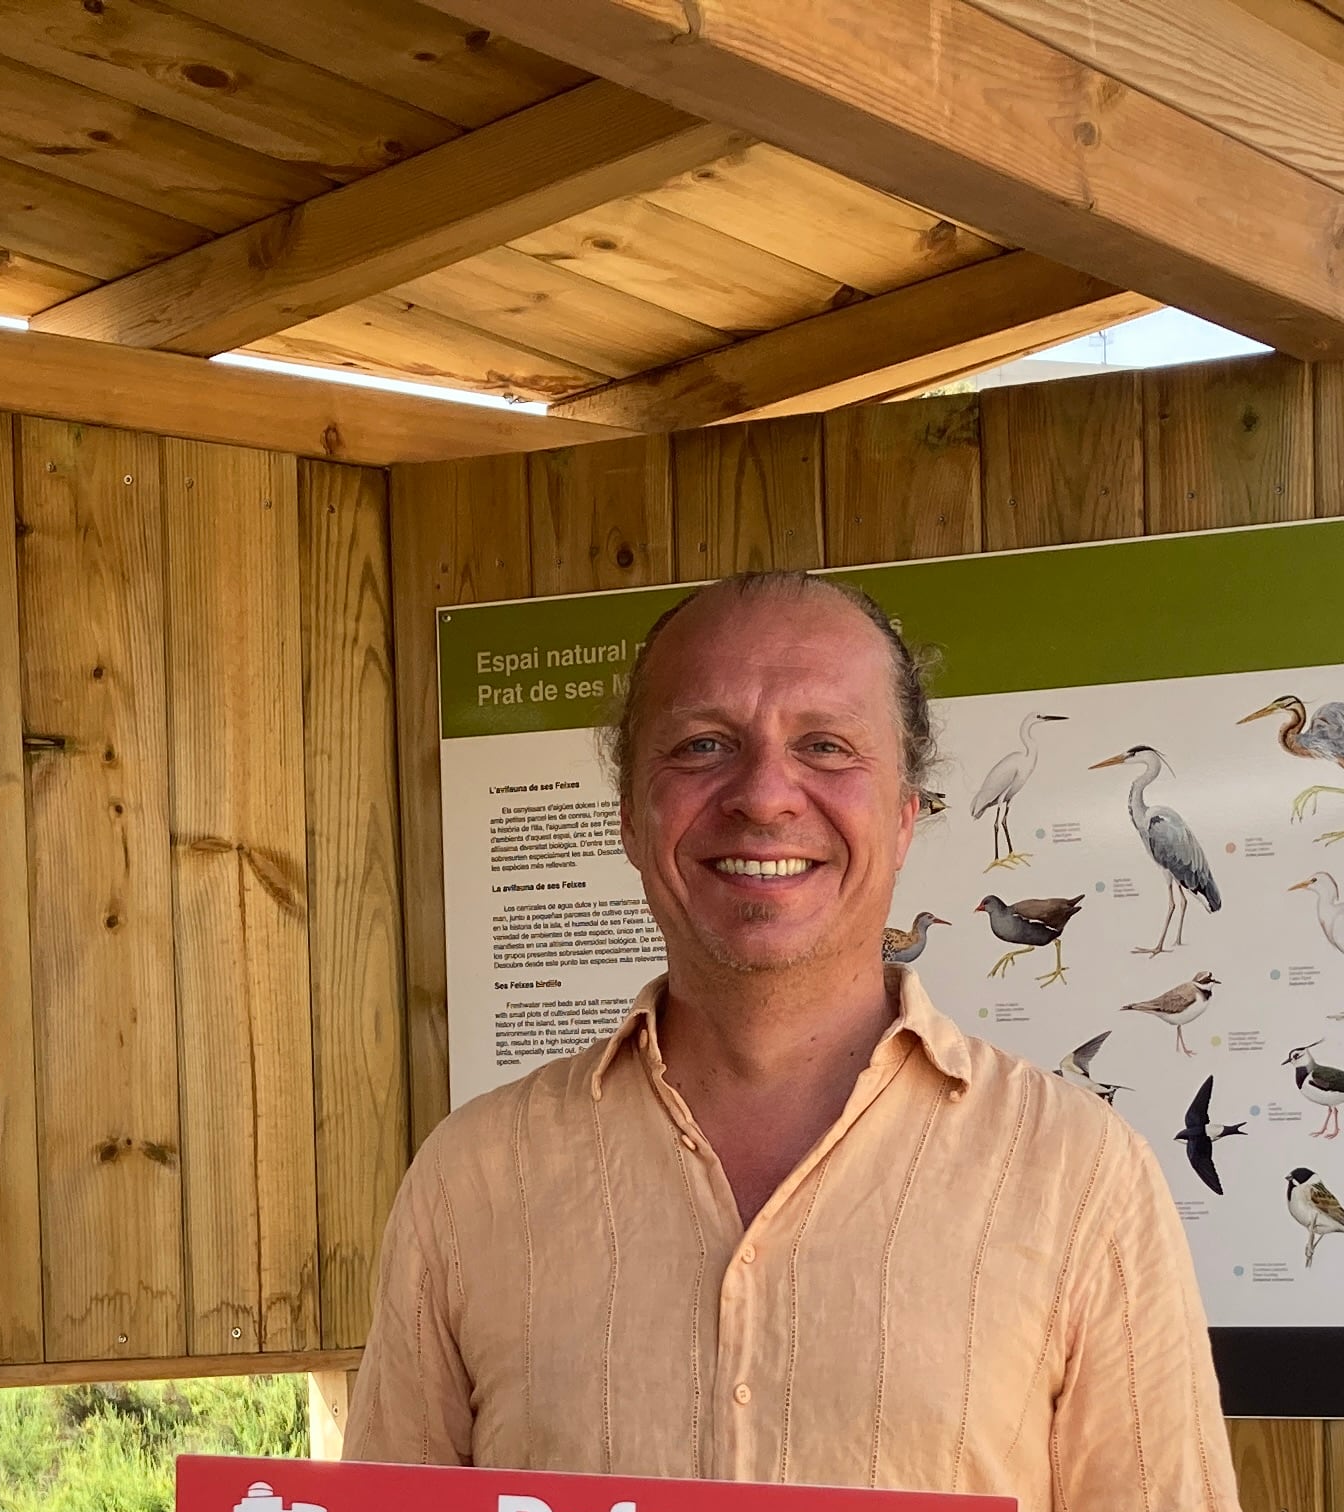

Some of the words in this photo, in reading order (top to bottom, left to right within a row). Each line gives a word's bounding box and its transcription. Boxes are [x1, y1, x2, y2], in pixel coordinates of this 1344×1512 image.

[477, 647, 539, 676] Espai
[547, 639, 626, 667] natural
[478, 683, 523, 706] Prat
[530, 680, 557, 701] de
[565, 679, 604, 699] ses
[529, 783, 538, 791] de
[555, 780, 579, 789] Feixes
[492, 885, 501, 893] La
[536, 882, 545, 890] de
[562, 879, 586, 888] Feixes
[494, 981, 508, 990] Ses
[510, 980, 534, 989] Feixes
